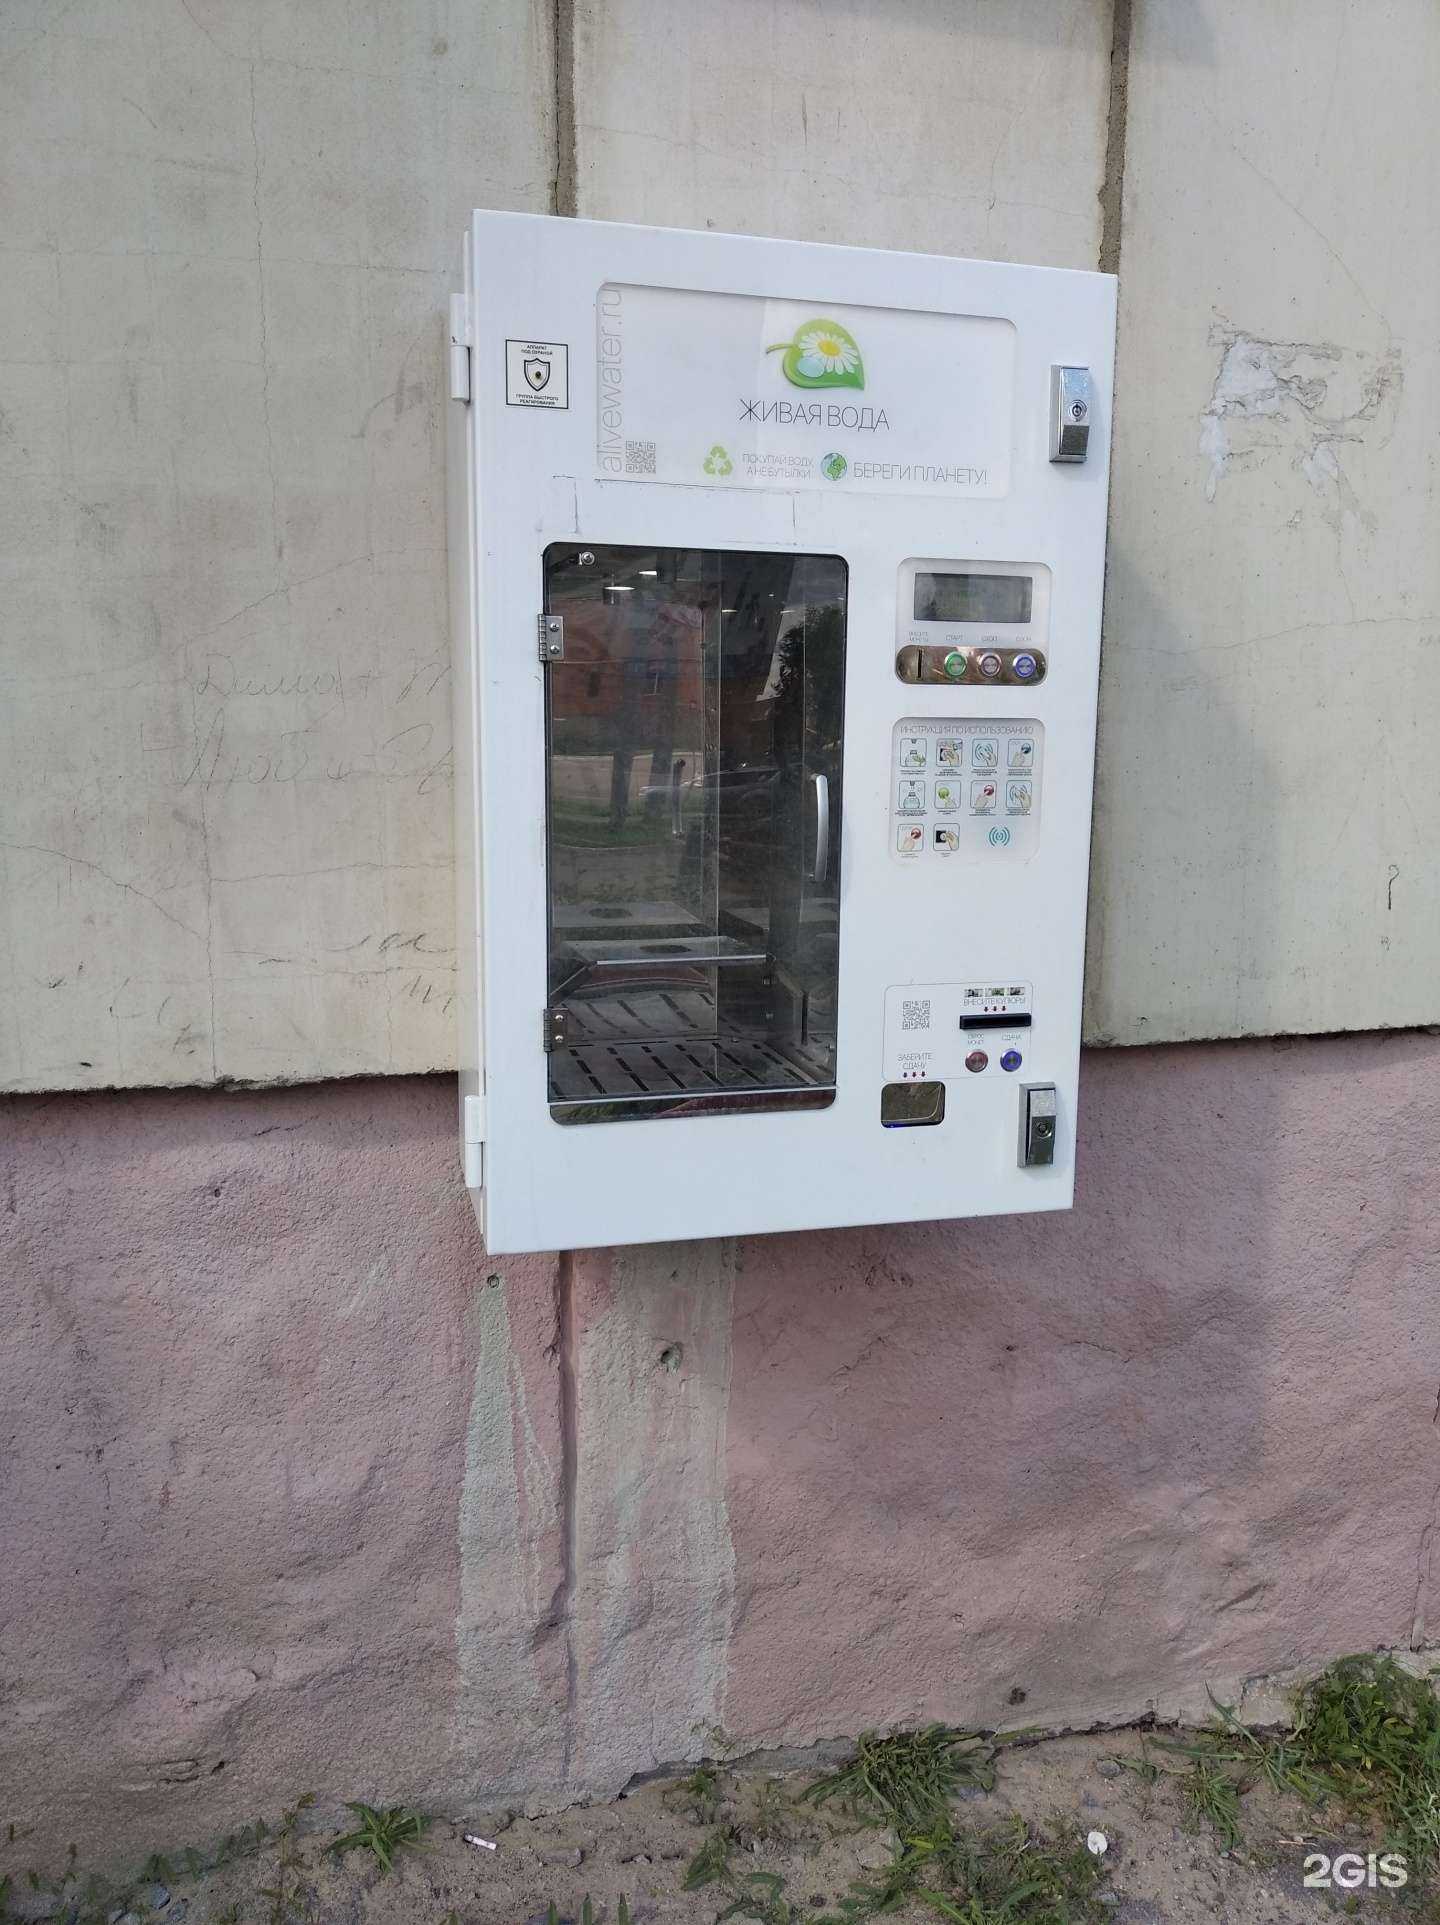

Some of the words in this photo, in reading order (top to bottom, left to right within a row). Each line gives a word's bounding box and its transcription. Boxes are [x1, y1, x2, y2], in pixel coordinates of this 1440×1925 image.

[597, 287, 623, 473] alivewater.ru
[739, 398, 822, 426] ЖИВАЯ
[827, 404, 890, 432] ВОДА
[853, 461, 911, 481] БЕРЕГИ
[914, 465, 988, 486] ПЛАНЕТУ!
